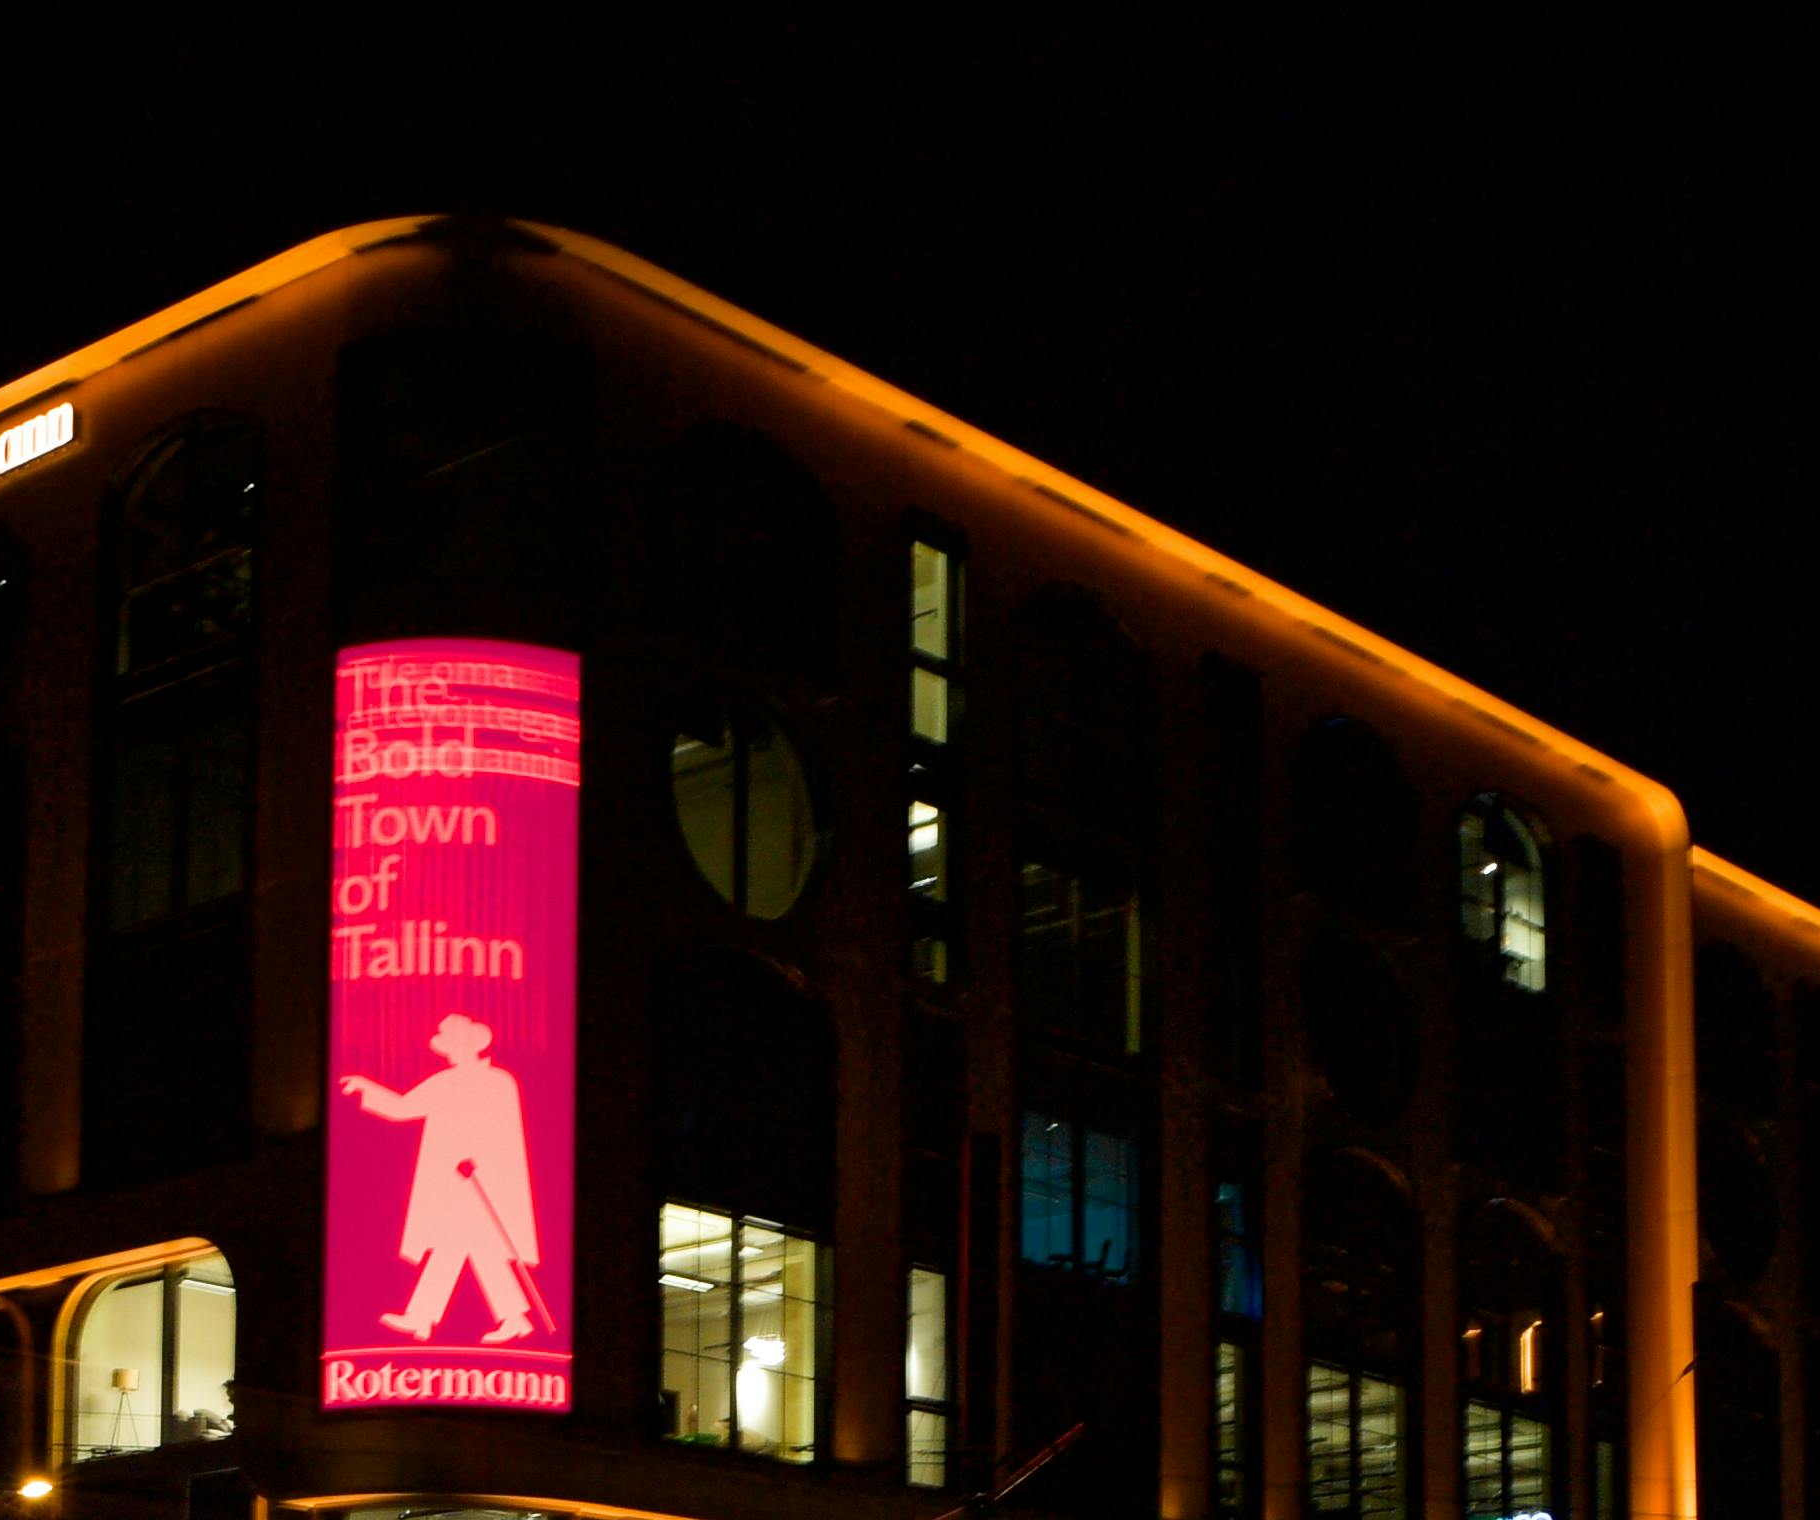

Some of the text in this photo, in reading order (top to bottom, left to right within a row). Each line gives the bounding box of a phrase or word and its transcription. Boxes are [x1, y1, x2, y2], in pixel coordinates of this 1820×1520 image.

[343, 721, 475, 784] Bold
[335, 792, 497, 849] Town
[337, 853, 402, 915] of
[332, 919, 524, 980] Tallinn
[326, 1359, 567, 1406] Rotermann
